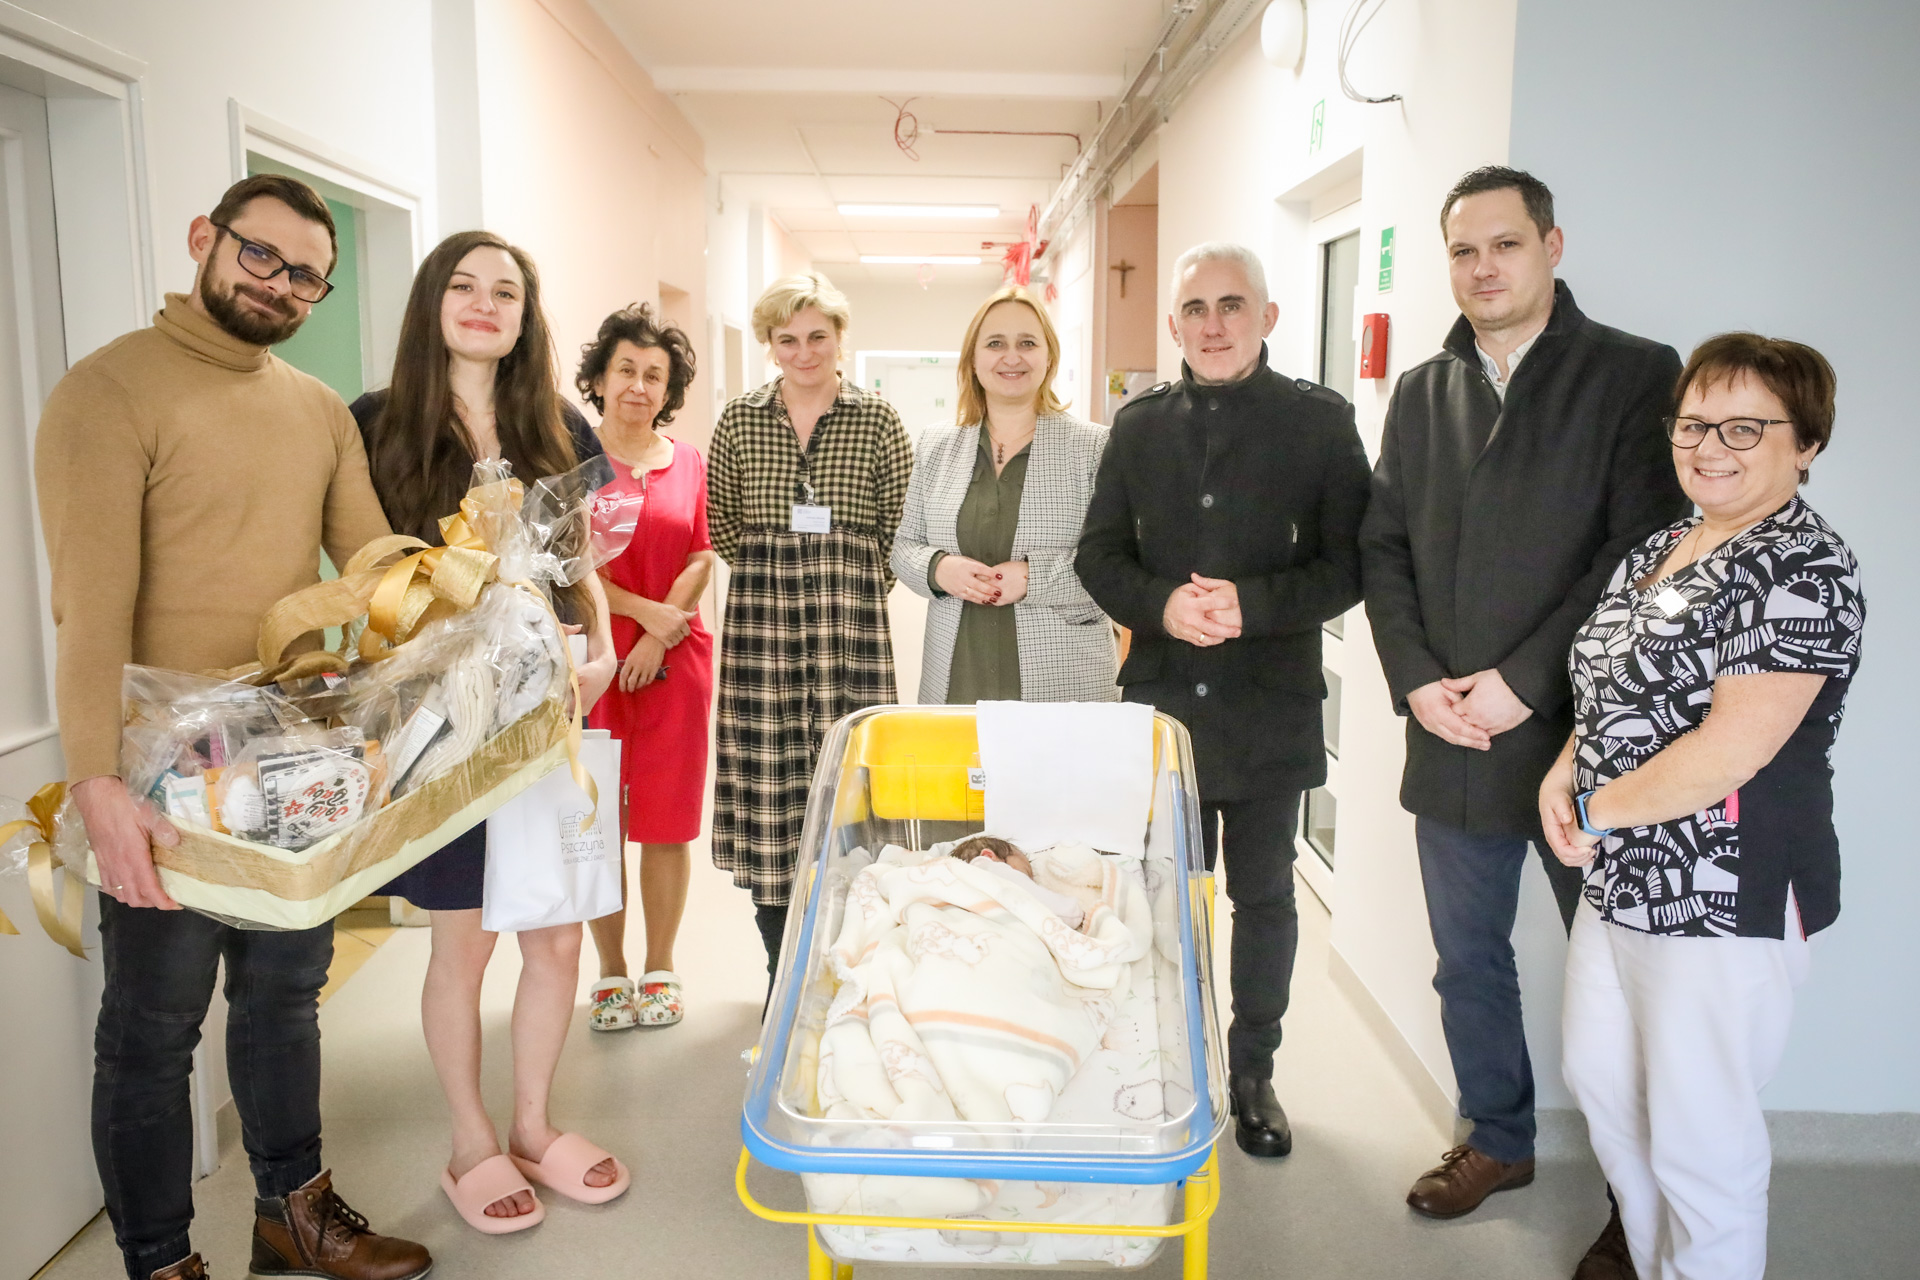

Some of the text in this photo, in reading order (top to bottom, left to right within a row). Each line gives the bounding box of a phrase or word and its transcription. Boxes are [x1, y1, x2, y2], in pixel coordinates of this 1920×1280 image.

[302, 781, 348, 806] Baby
[305, 801, 349, 822] Jolly
[561, 840, 604, 855] Pszczyna
